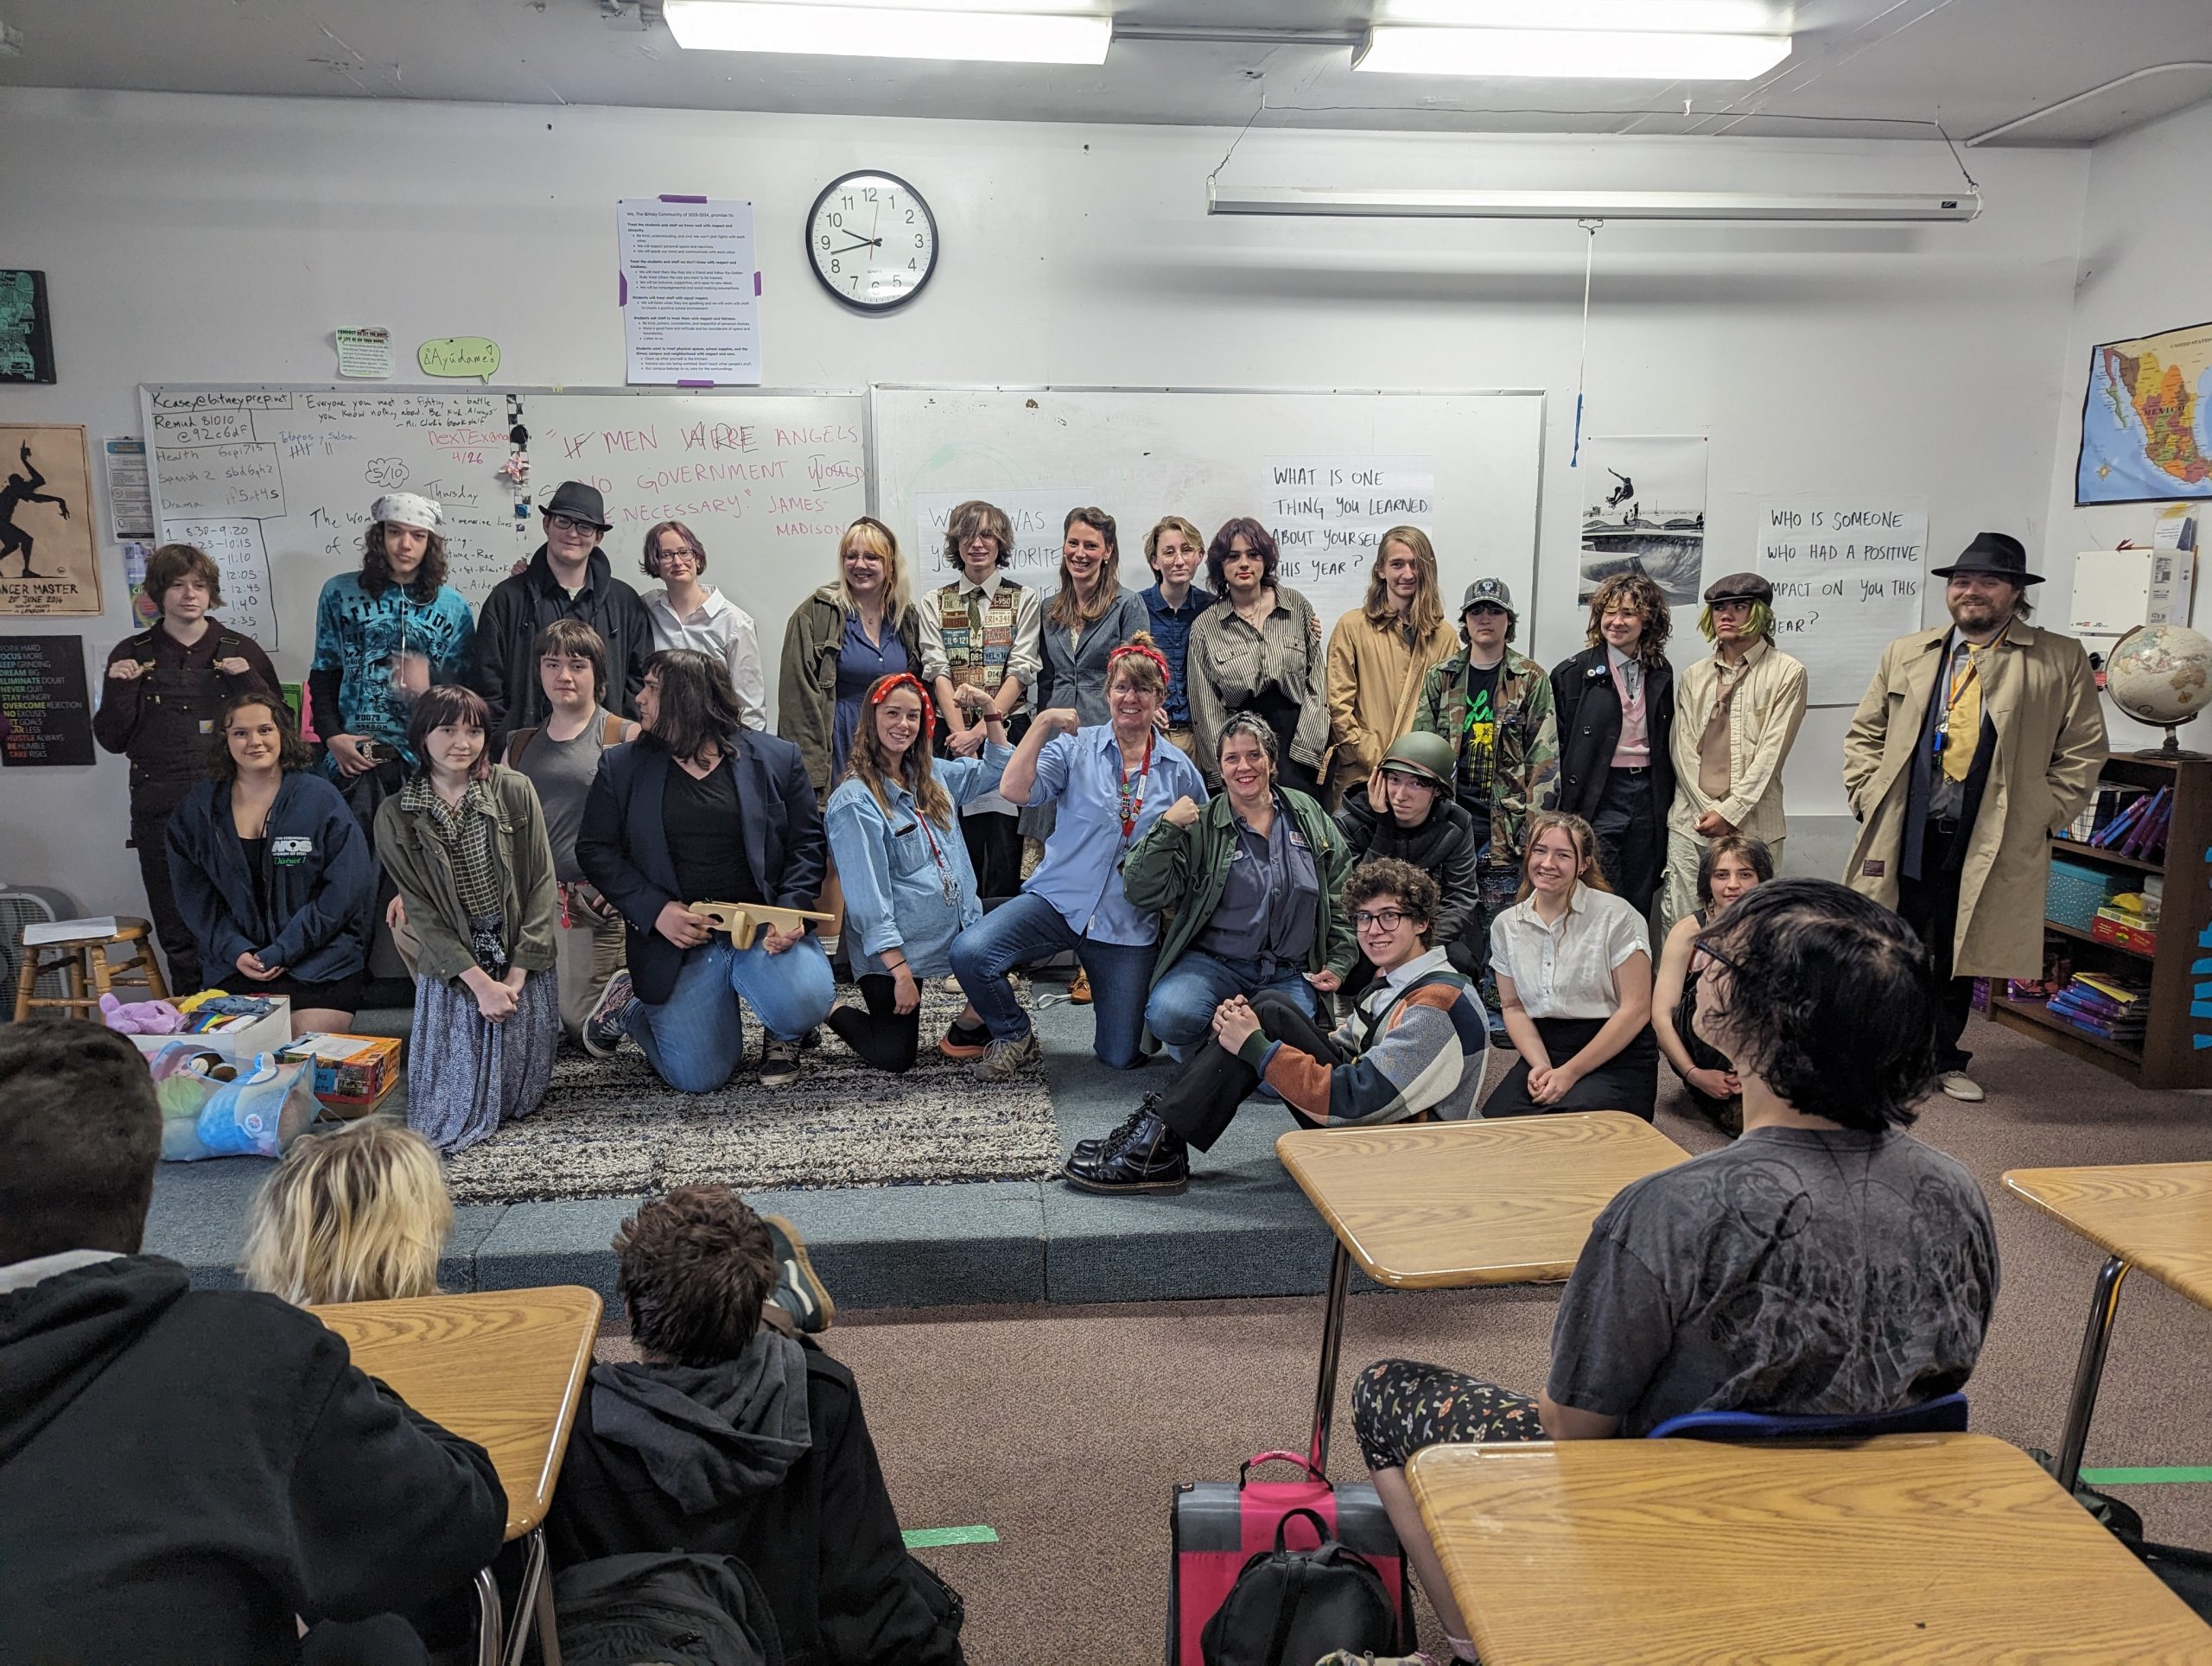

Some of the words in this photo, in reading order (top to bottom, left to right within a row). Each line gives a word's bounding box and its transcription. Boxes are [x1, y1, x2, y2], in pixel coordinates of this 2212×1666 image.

[841, 195, 854, 210] 11
[861, 188, 878, 202] 12
[888, 194, 894, 209] 1
[826, 213, 842, 227] 10
[906, 209, 914, 224] 2
[821, 236, 830, 250] 9
[914, 233, 924, 248] 3
[831, 259, 841, 273] 8
[907, 258, 917, 272] 4
[850, 276, 859, 289] 7
[893, 275, 902, 288] 5
[353, 399, 372, 411] you
[467, 394, 491, 406] battle
[2144, 405, 2185, 416] MEXICO
[154, 416, 197, 429] Remind
[201, 416, 234, 426] 81010
[603, 424, 658, 455] MEN
[156, 450, 199, 462] Health
[452, 452, 484, 464] 4/26
[158, 472, 199, 485] Spanish
[373, 469, 403, 479] 5/10
[637, 461, 788, 493] GOVERNMENT
[1274, 467, 1318, 486] WHAT
[1331, 469, 1343, 486] IS
[1351, 469, 1384, 486] ONE
[162, 499, 205, 510] Drama
[768, 494, 825, 513] JAMES
[1273, 496, 1325, 519] THING
[1370, 498, 1427, 516] LEARNED
[309, 506, 340, 529] The
[1771, 510, 1802, 529] WHO
[1811, 512, 1824, 525] IS
[1833, 512, 1904, 531] SOMEONE
[326, 536, 340, 555] of
[1272, 528, 1315, 546] ABOUT
[1323, 529, 1384, 551] YOURSEL
[1767, 544, 1796, 563] WHO
[1810, 544, 1838, 561] HAD
[1847, 544, 1855, 560] A
[1864, 544, 1920, 561] POSITIVE
[34, 584, 79, 595] MASTER
[1771, 582, 1811, 597] MPACT
[1822, 580, 1843, 596] ON
[1891, 580, 1916, 596] THIS
[340, 600, 453, 639] AFFLICTION
